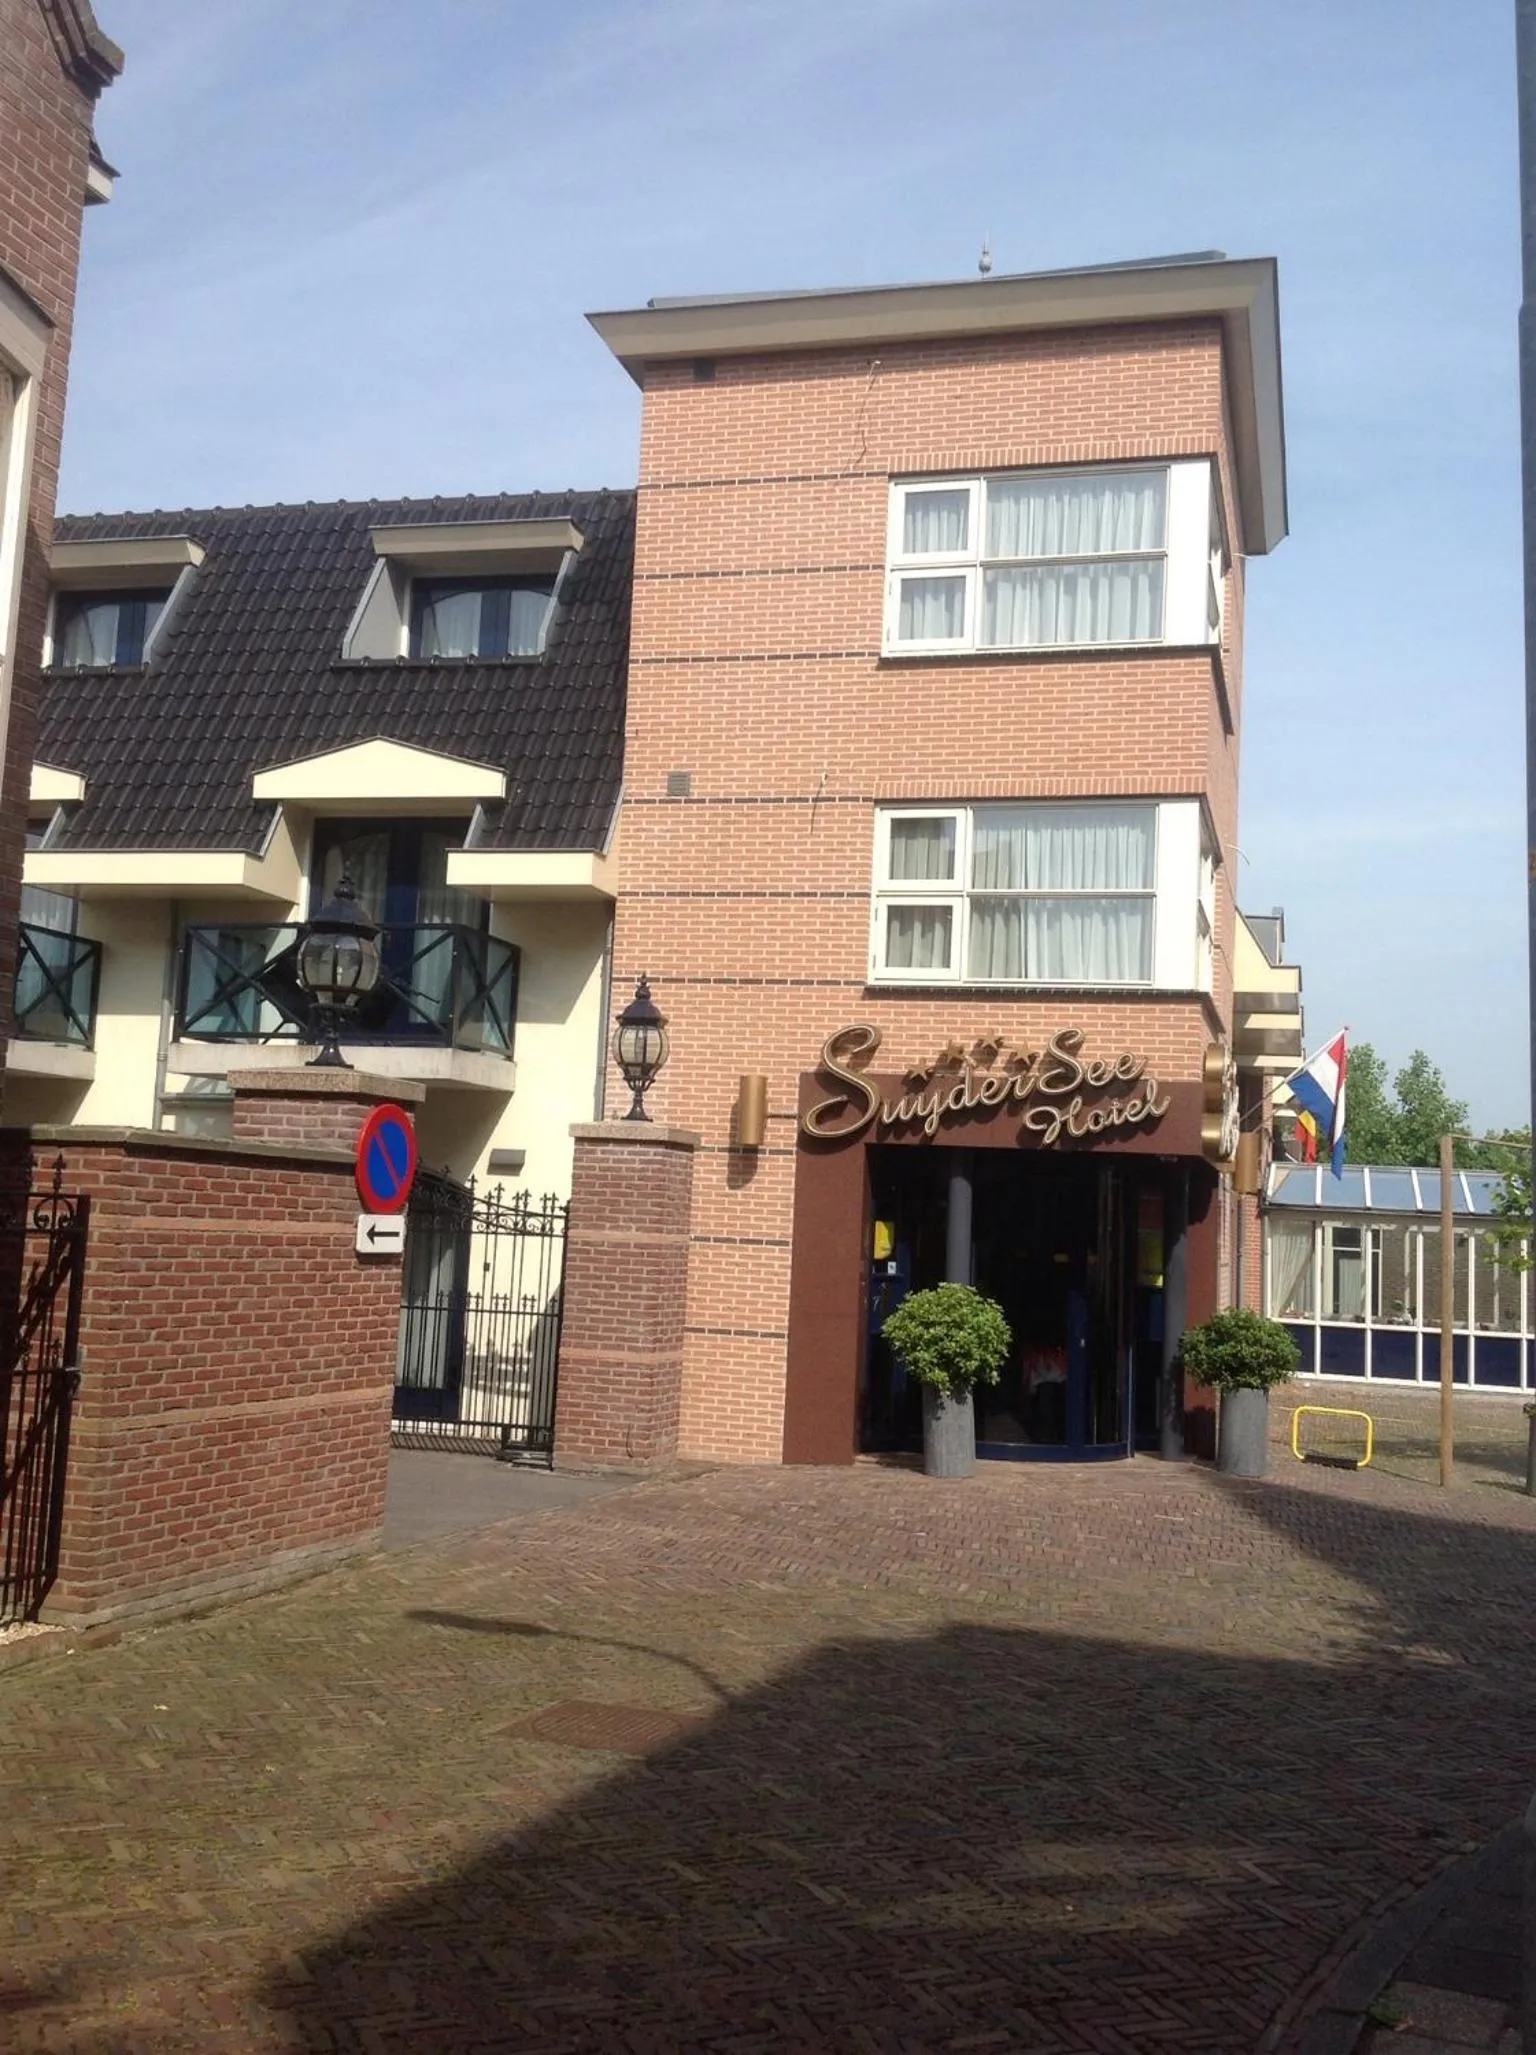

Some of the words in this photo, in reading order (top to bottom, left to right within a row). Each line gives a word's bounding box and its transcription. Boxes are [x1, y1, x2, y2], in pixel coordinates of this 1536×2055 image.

[802, 1023, 1039, 1138] Suyder
[1037, 1027, 1147, 1094] See
[1024, 1078, 1171, 1145] Hotel
